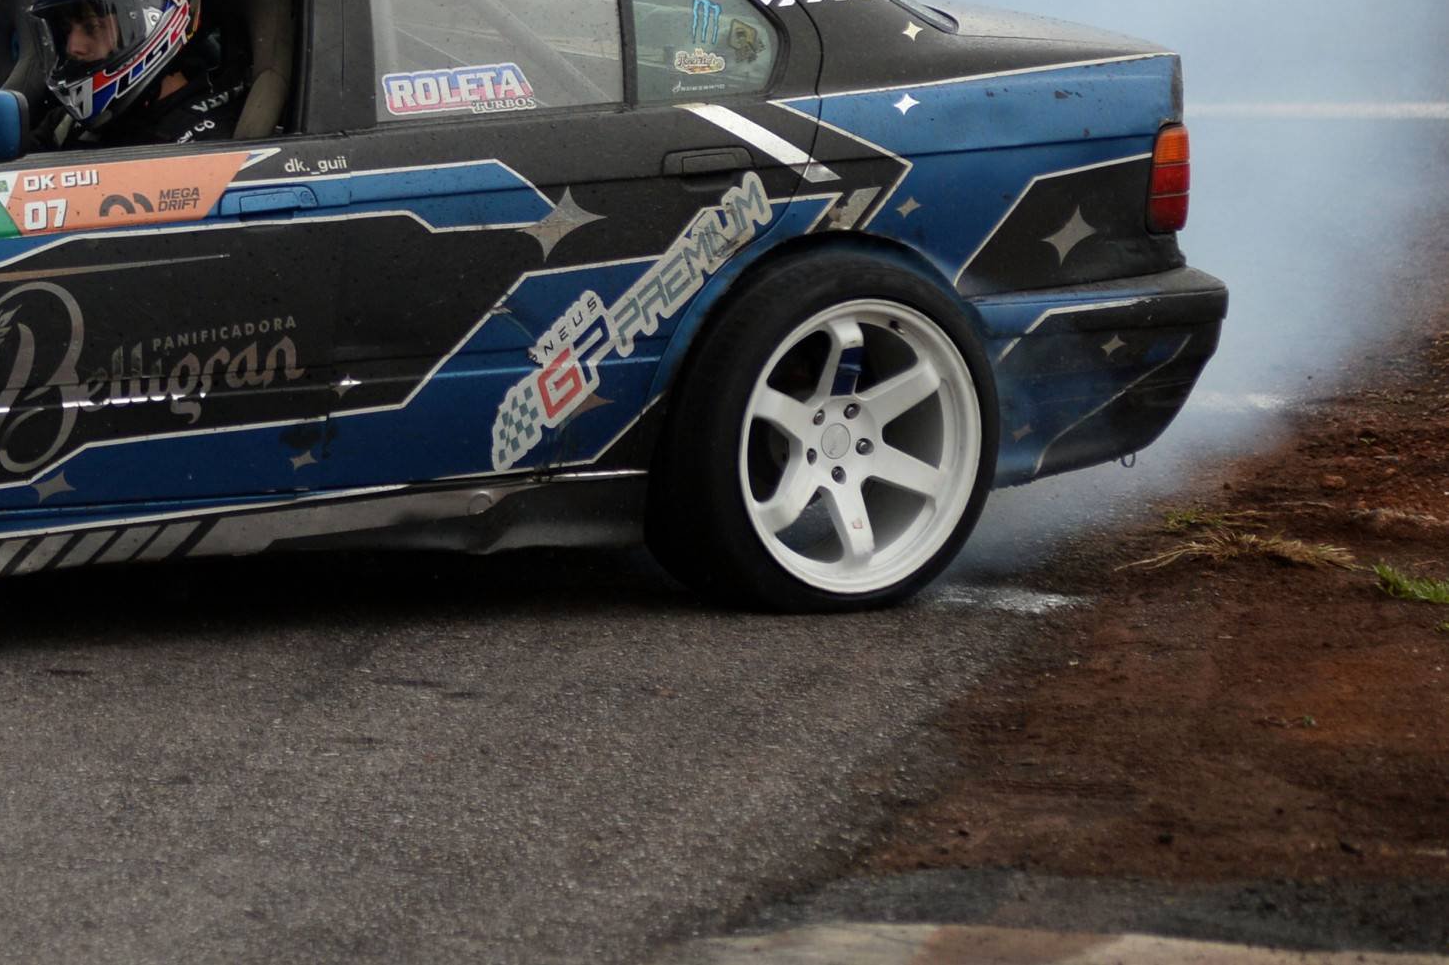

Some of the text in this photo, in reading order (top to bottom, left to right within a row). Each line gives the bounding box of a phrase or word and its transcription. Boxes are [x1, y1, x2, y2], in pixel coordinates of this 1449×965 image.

[388, 68, 527, 109] ROLETA
[475, 96, 537, 112] TURBOS
[283, 155, 348, 175] dk._guii
[23, 169, 100, 192] DK GUI
[158, 187, 201, 201] MEGA
[24, 198, 68, 231] 07
[157, 198, 201, 212] DRIFT
[152, 314, 298, 352] PANIFICADORA
